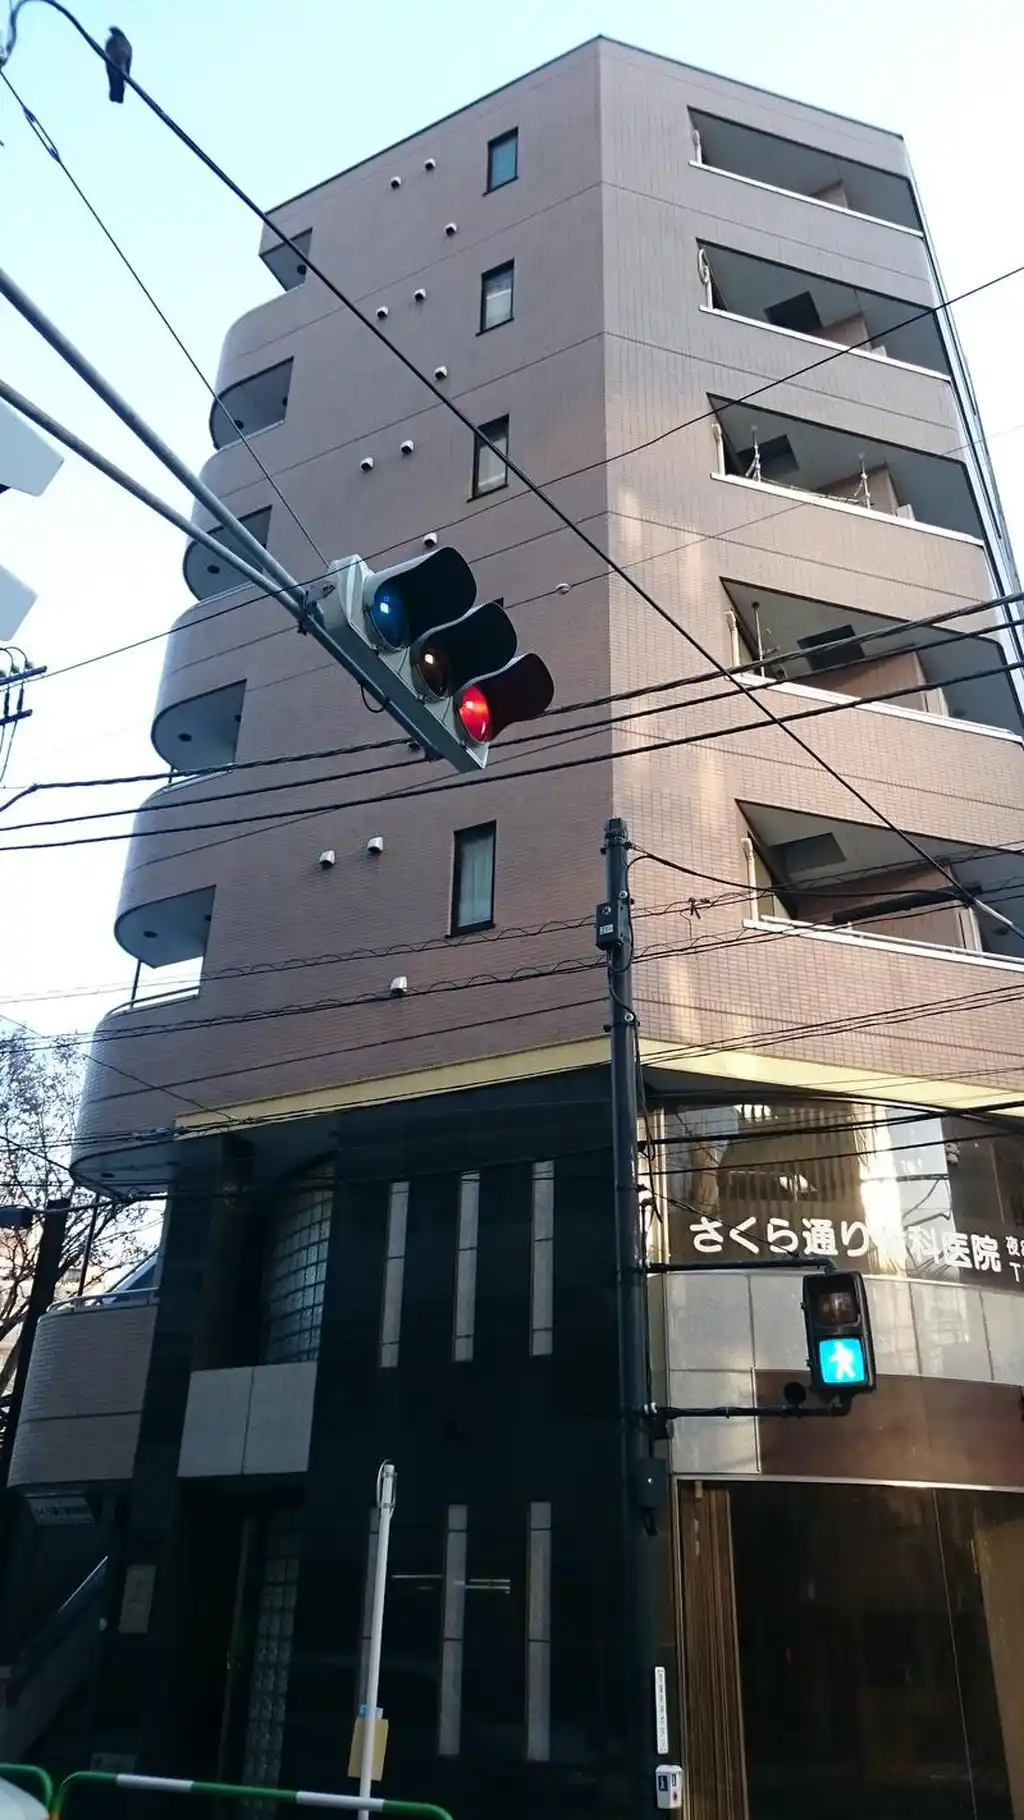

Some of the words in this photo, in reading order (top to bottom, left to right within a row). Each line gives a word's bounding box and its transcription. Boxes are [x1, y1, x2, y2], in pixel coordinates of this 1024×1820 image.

[689, 1217, 1001, 1272] さくら通り科医院
